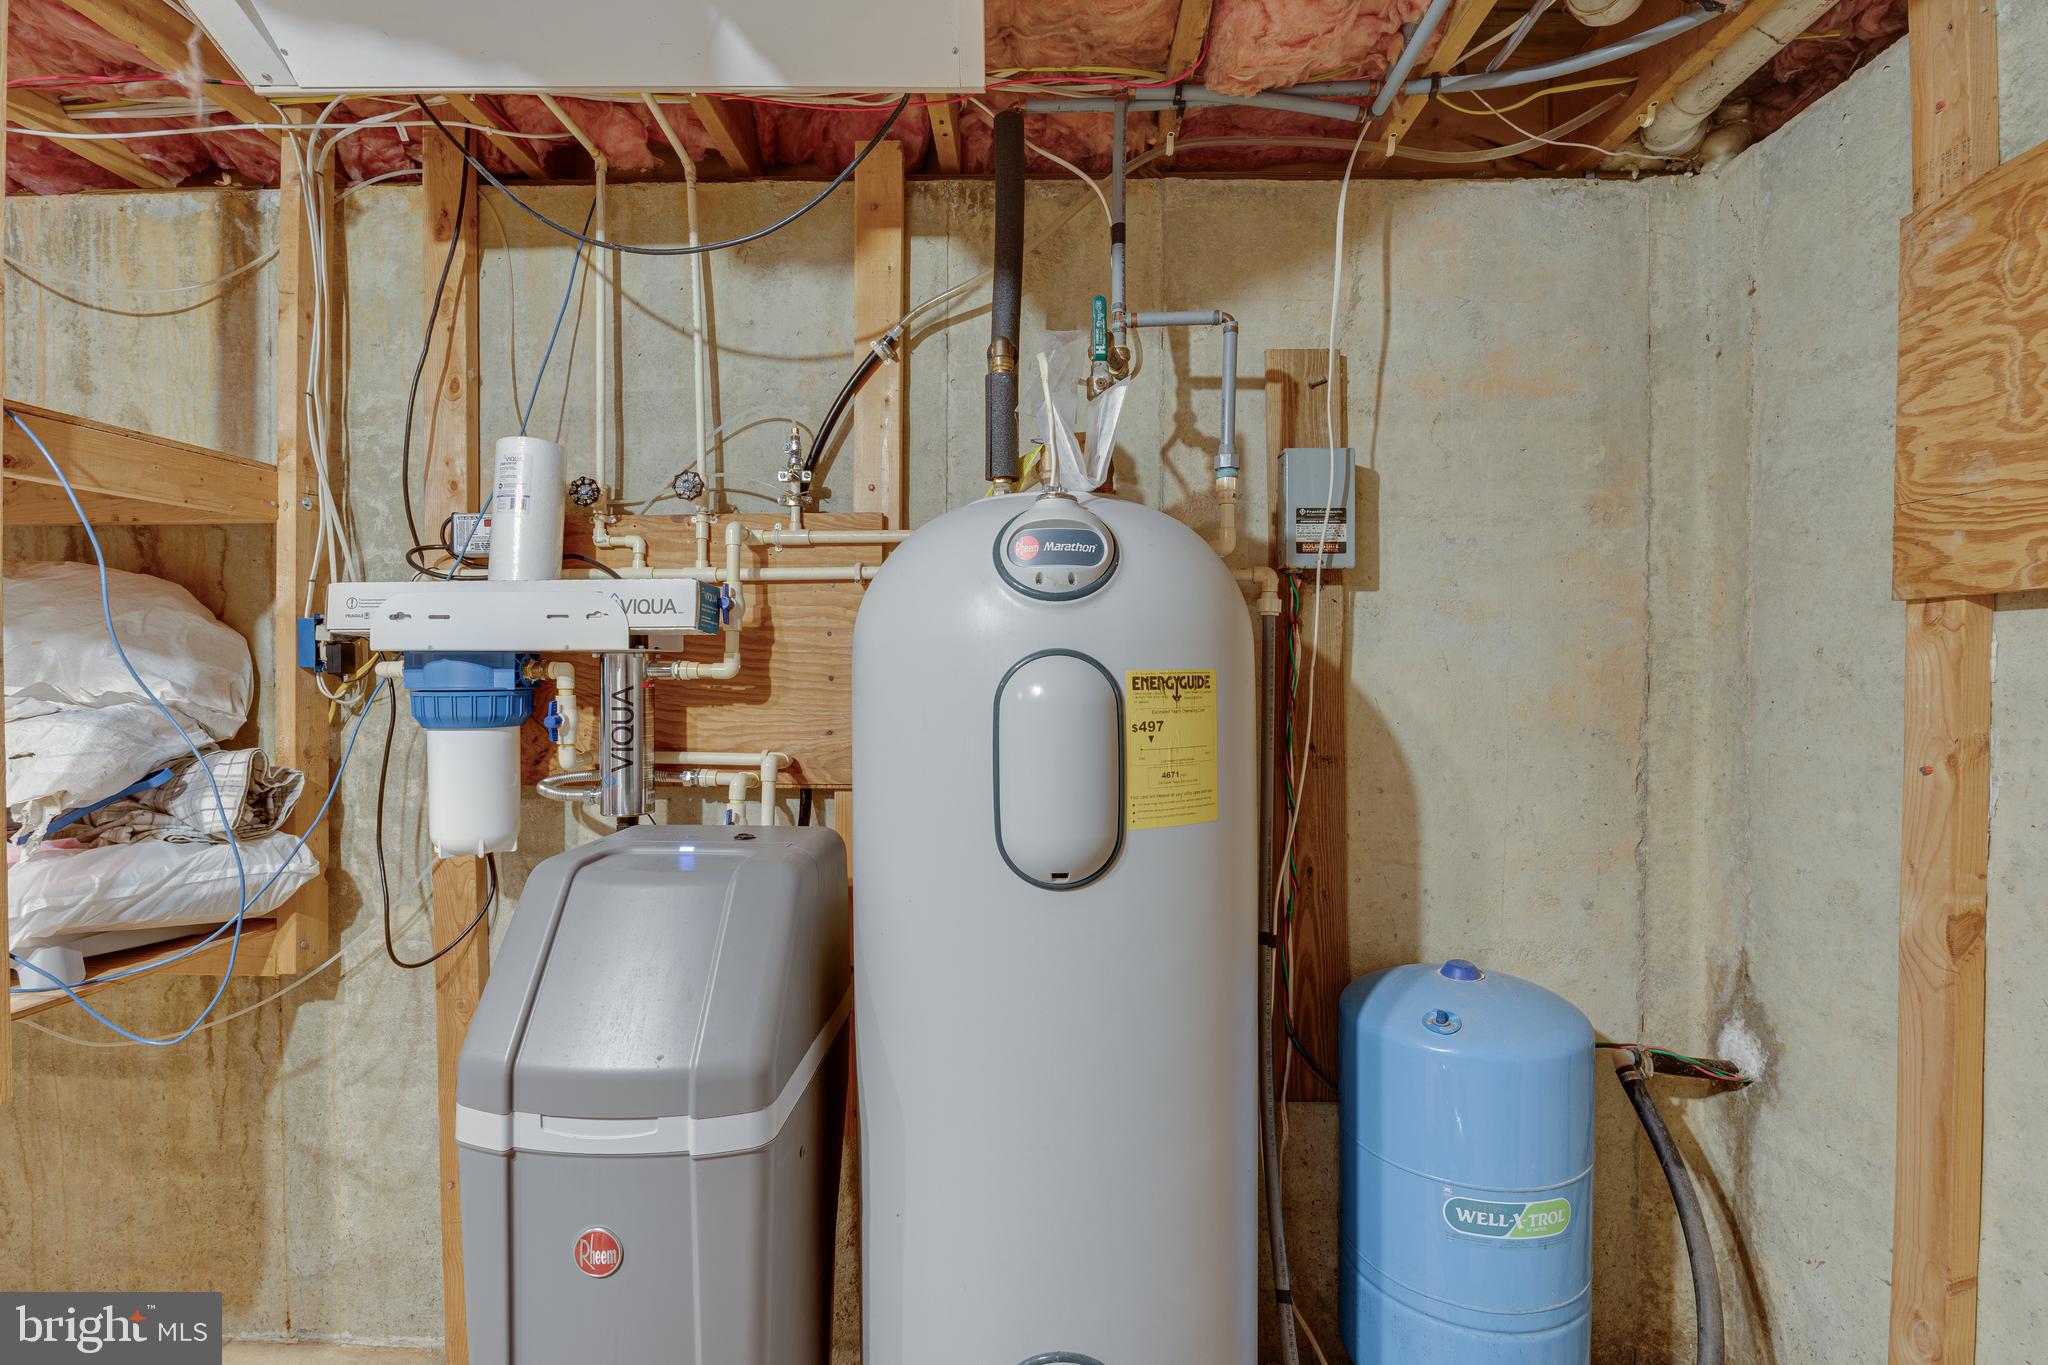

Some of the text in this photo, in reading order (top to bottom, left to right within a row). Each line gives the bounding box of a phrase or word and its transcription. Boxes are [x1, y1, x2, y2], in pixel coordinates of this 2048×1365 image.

[1015, 536, 1096, 557] Rheem Marathon
[620, 598, 677, 615] VIQUA
[1132, 675, 1211, 696] ENERGYGUIDE
[611, 685, 634, 772] VIQUA
[1131, 720, 1164, 733] $497
[1161, 771, 1180, 779] 4671
[1455, 1207, 1565, 1230] WELL-X-TROL
[579, 1233, 617, 1270] Rheem
